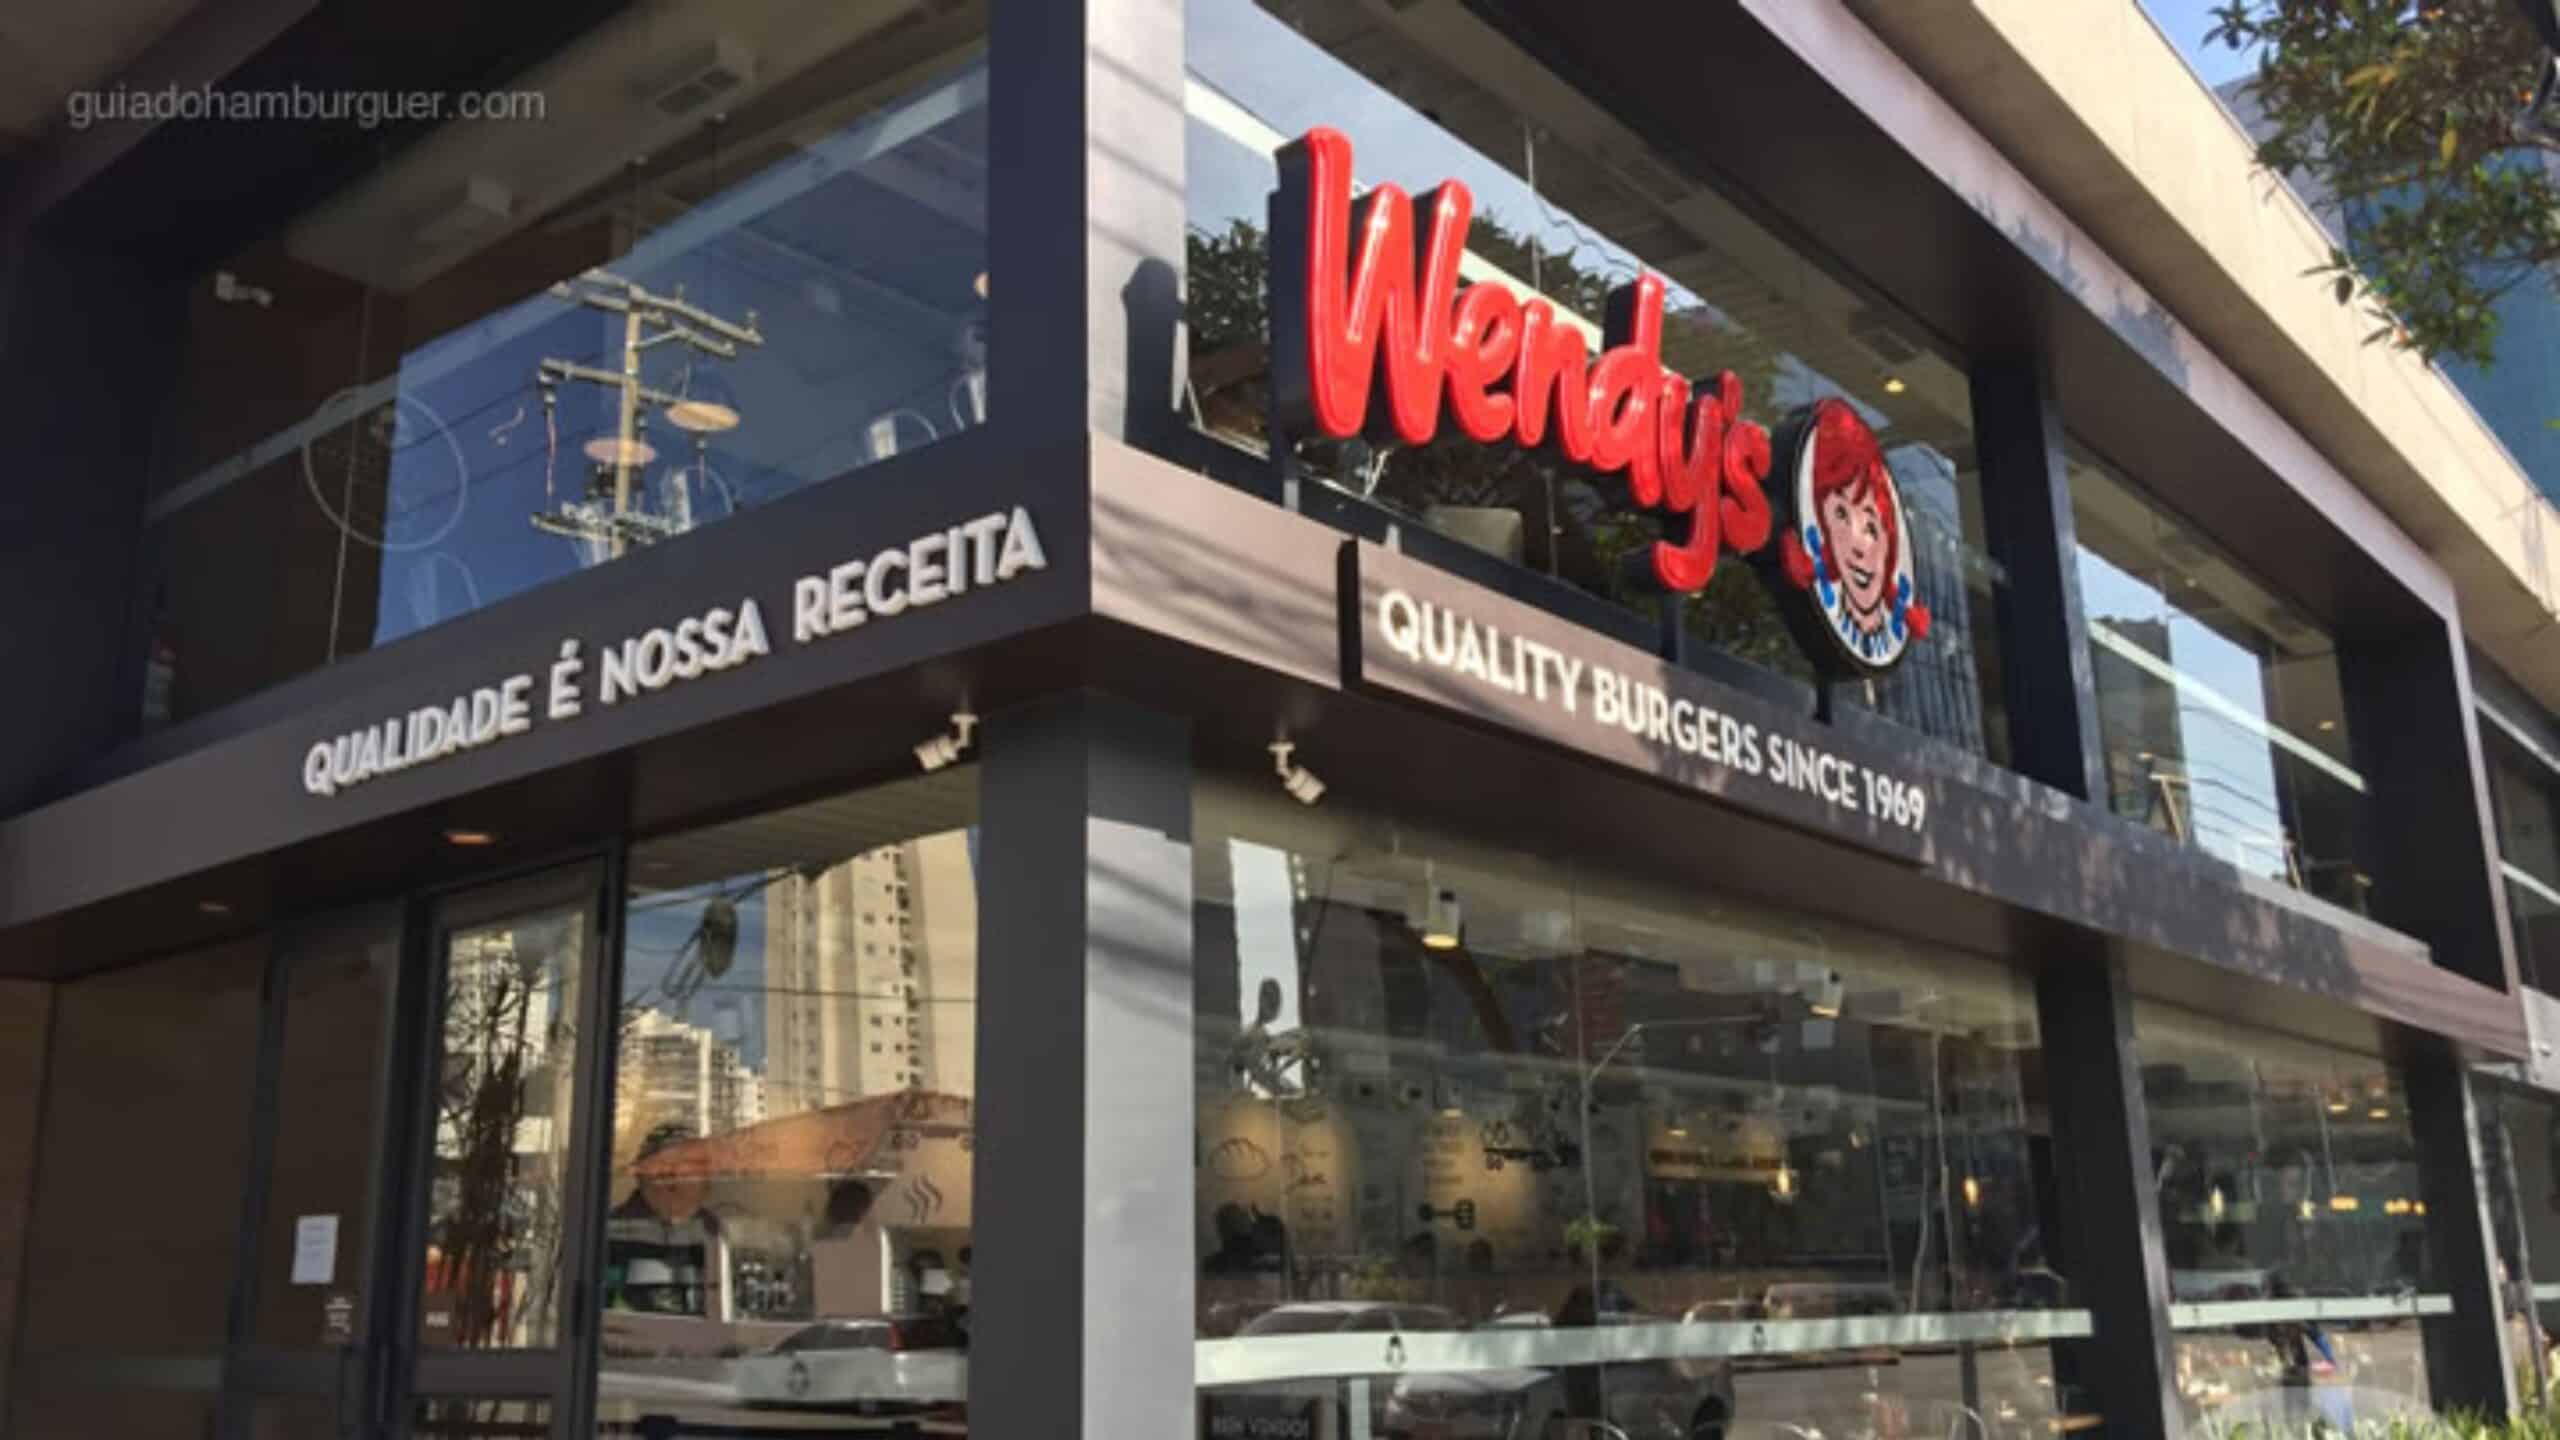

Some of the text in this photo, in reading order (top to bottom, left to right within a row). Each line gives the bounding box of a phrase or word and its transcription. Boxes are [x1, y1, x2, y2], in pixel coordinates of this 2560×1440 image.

[1306, 126, 1773, 593] Wendy's
[304, 505, 1047, 796] QUALIDADE É NOSSA RECEITA
[1378, 588, 1926, 833] QUALITY BURGERS SINCE 1969
